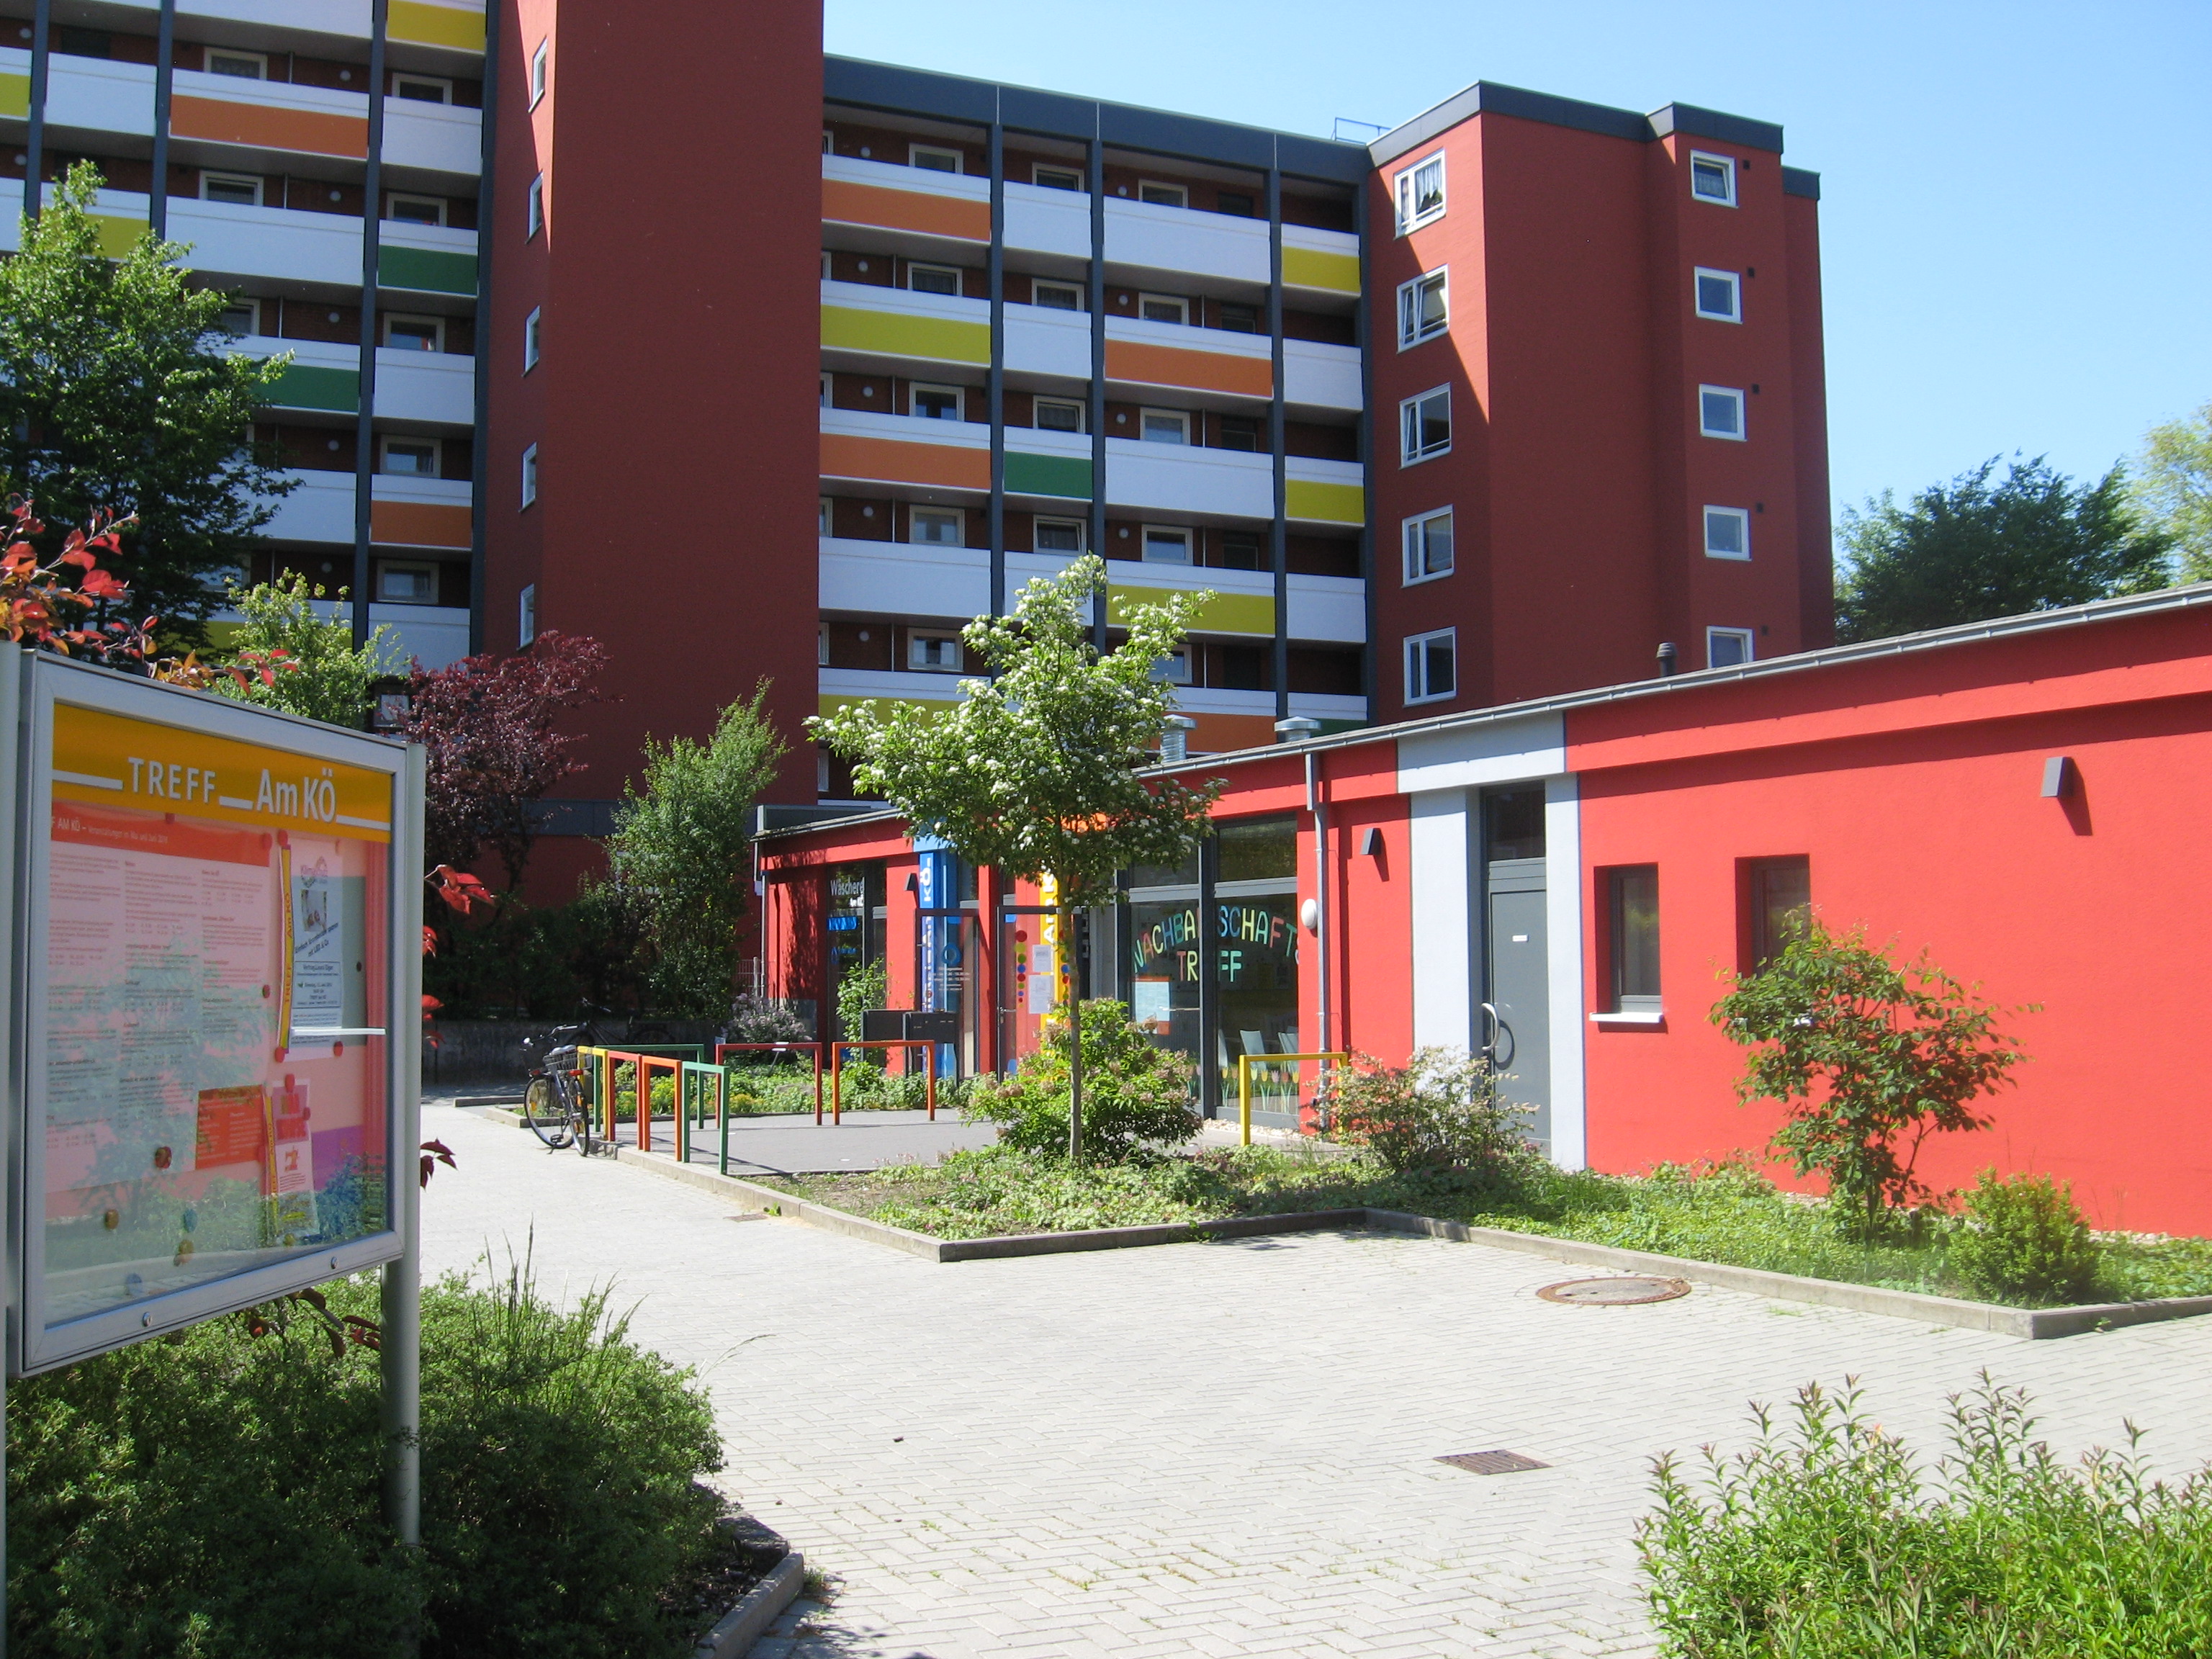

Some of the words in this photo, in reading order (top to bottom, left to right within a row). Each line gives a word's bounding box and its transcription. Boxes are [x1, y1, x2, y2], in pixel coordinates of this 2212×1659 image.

[127, 756, 215, 804] TREFF
[256, 768, 297, 817] Am
[303, 767, 336, 822] KÖ
[830, 876, 864, 896] Wäschere
[920, 867, 932, 902] KÖ
[1133, 905, 1299, 974] NACHBASCHAFT
[1177, 950, 1242, 983] TRFF
